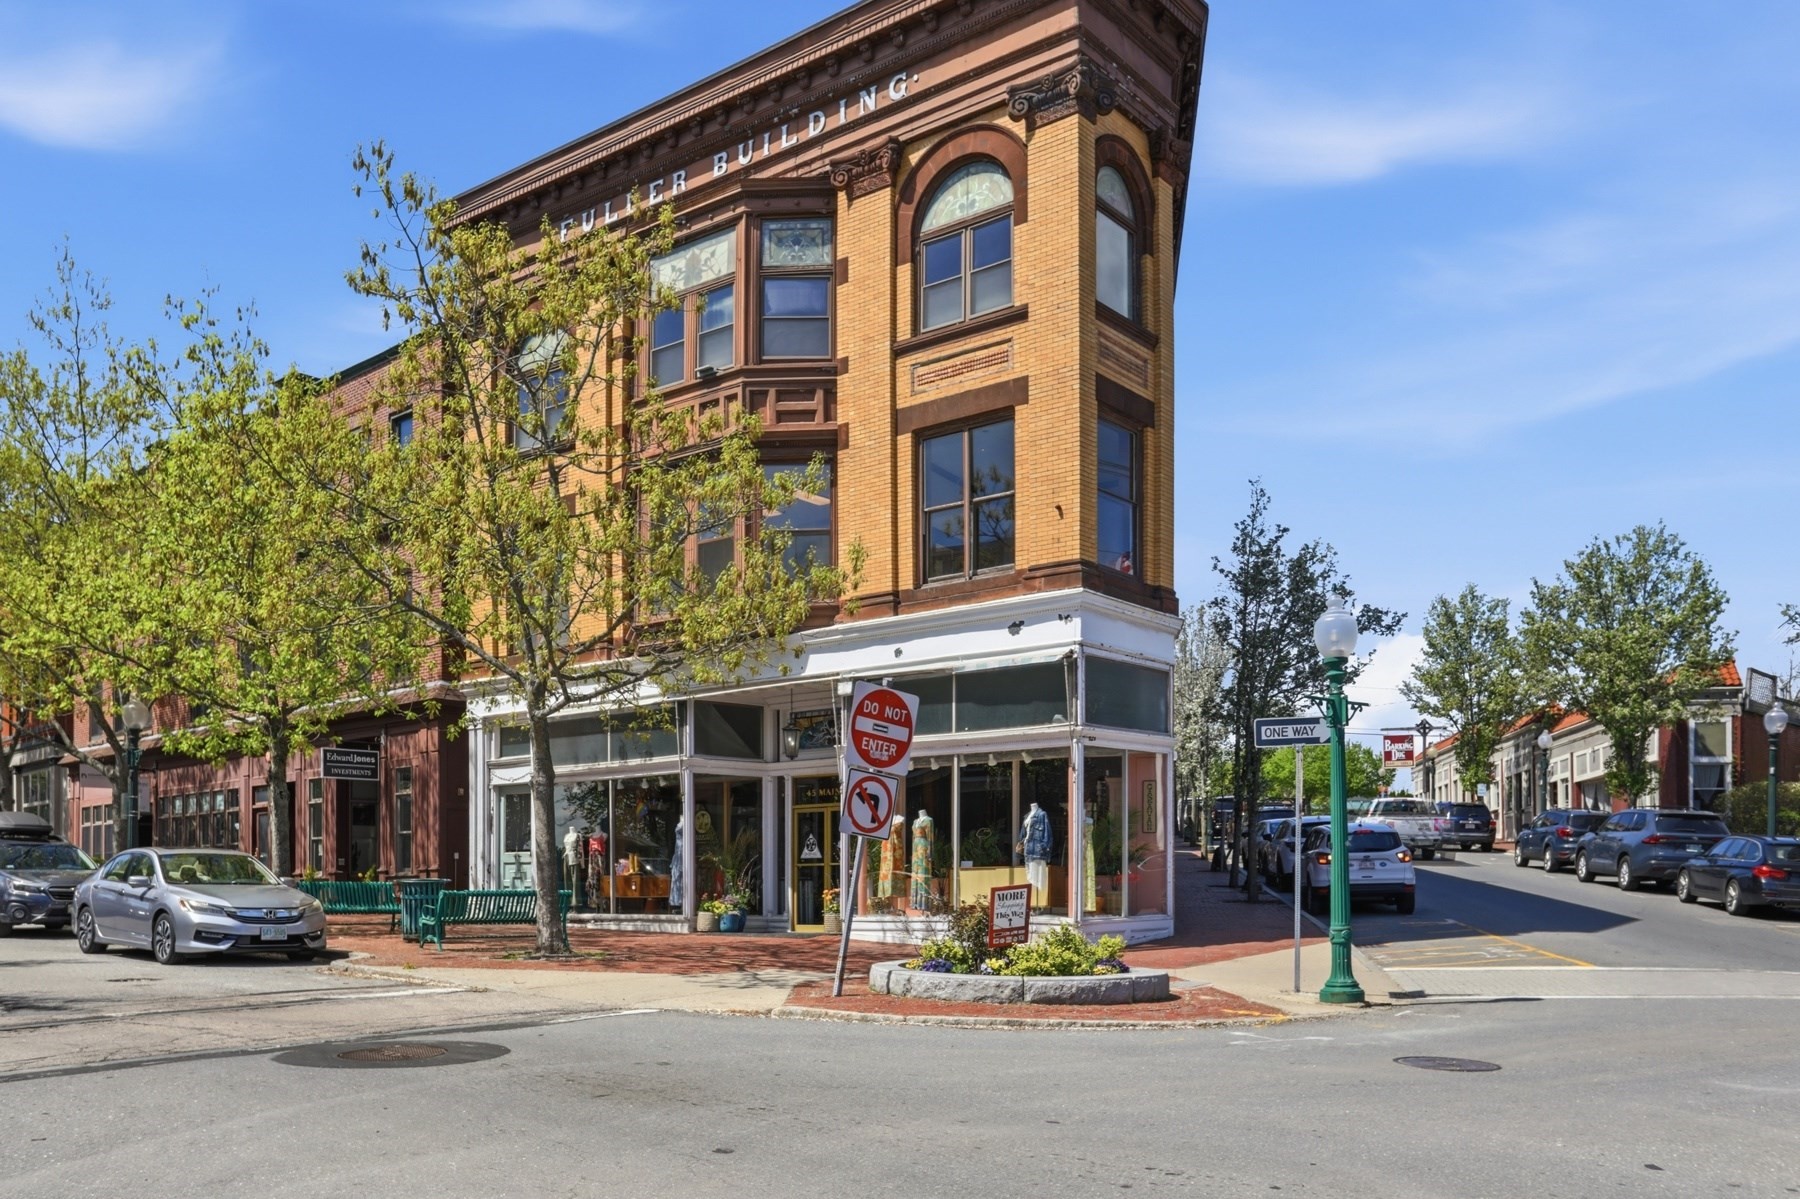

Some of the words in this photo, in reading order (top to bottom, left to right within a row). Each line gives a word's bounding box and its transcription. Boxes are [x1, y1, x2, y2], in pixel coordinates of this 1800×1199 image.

[863, 700, 879, 714] DO
[884, 706, 908, 722] NOT
[1264, 727, 1288, 738] ONE
[1292, 726, 1316, 737] WAY
[861, 736, 897, 757] ENTER
[331, 767, 372, 776] INVESTMENTS
[997, 890, 1026, 902] MORE
[996, 911, 1010, 919] This
